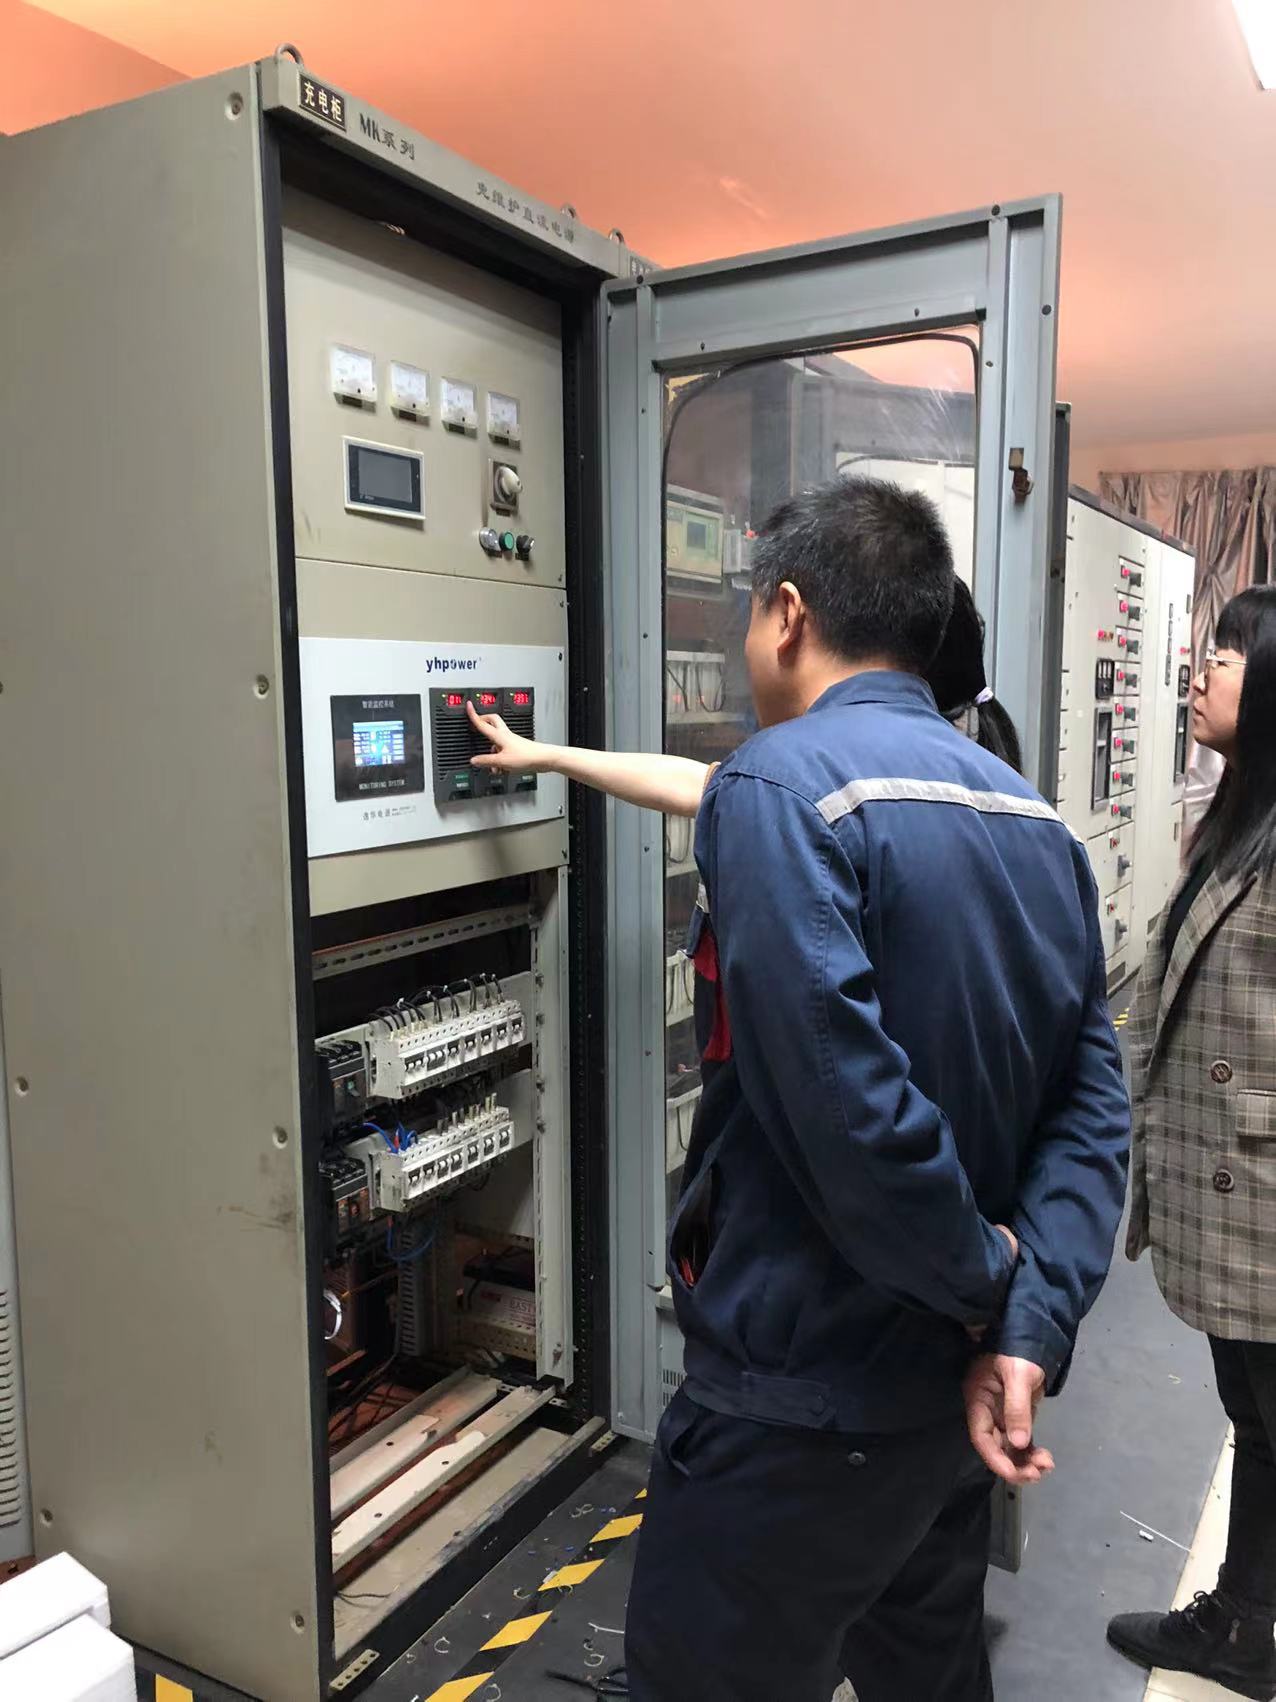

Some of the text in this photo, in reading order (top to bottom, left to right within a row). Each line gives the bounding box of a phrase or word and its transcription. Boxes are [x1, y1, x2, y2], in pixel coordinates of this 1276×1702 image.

[304, 80, 343, 122] 充电柜
[360, 112, 415, 161] MK系列
[426, 656, 477, 673] yhpower
